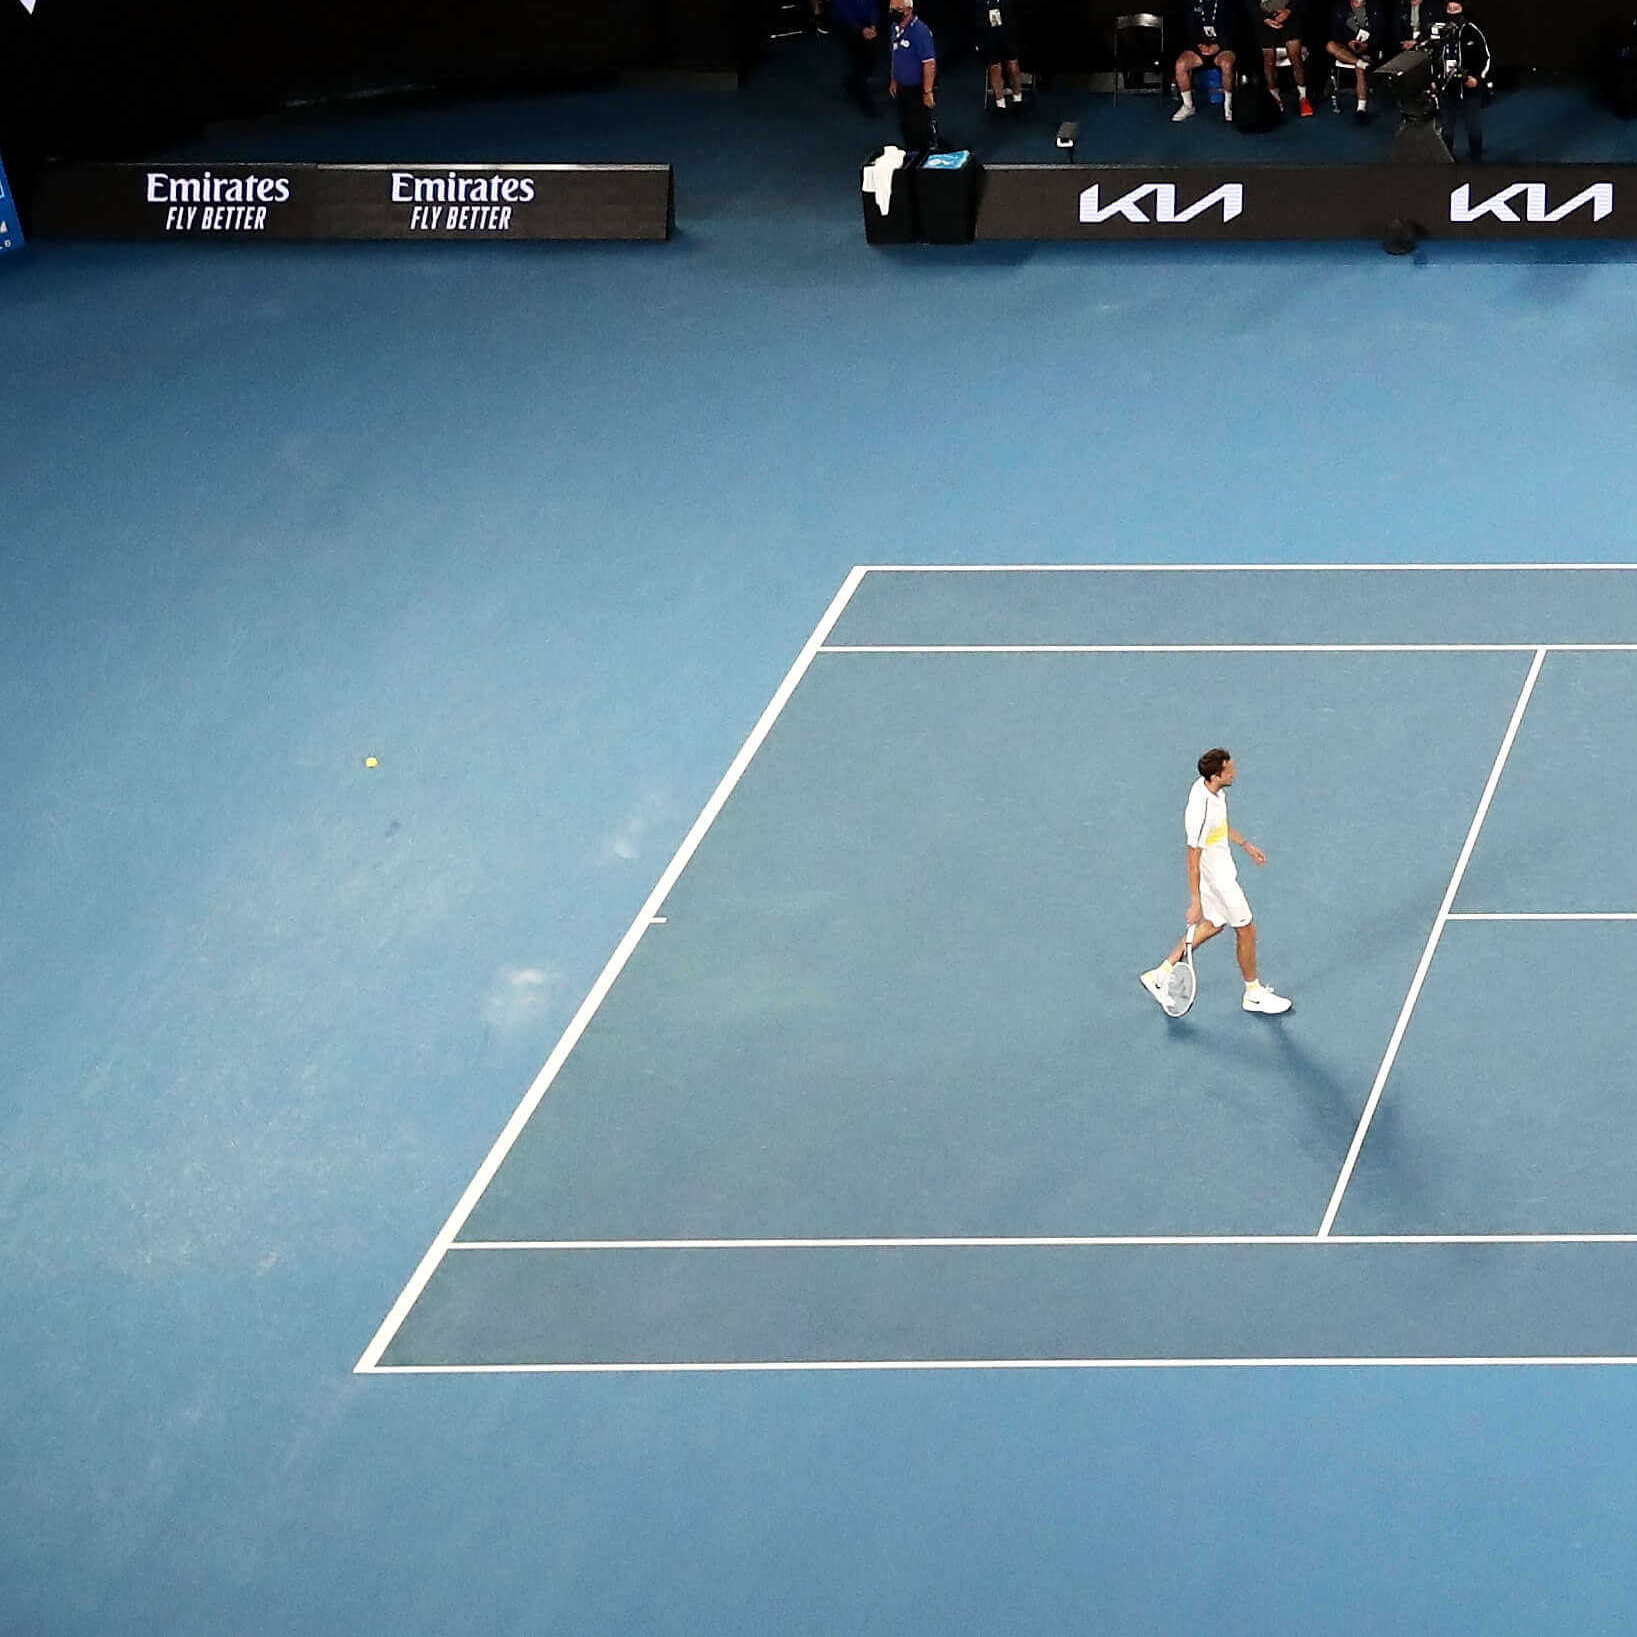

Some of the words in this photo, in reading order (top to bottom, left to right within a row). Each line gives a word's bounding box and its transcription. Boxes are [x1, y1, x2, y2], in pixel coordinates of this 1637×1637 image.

[147, 172, 290, 203] Emirates
[391, 172, 535, 203] Emirates
[1080, 183, 1243, 223] KIA
[1450, 183, 1614, 222] KIA
[166, 206, 197, 230] FLY
[201, 206, 267, 230] BETTER
[411, 206, 442, 230] FLY
[446, 206, 511, 230] BETTER
